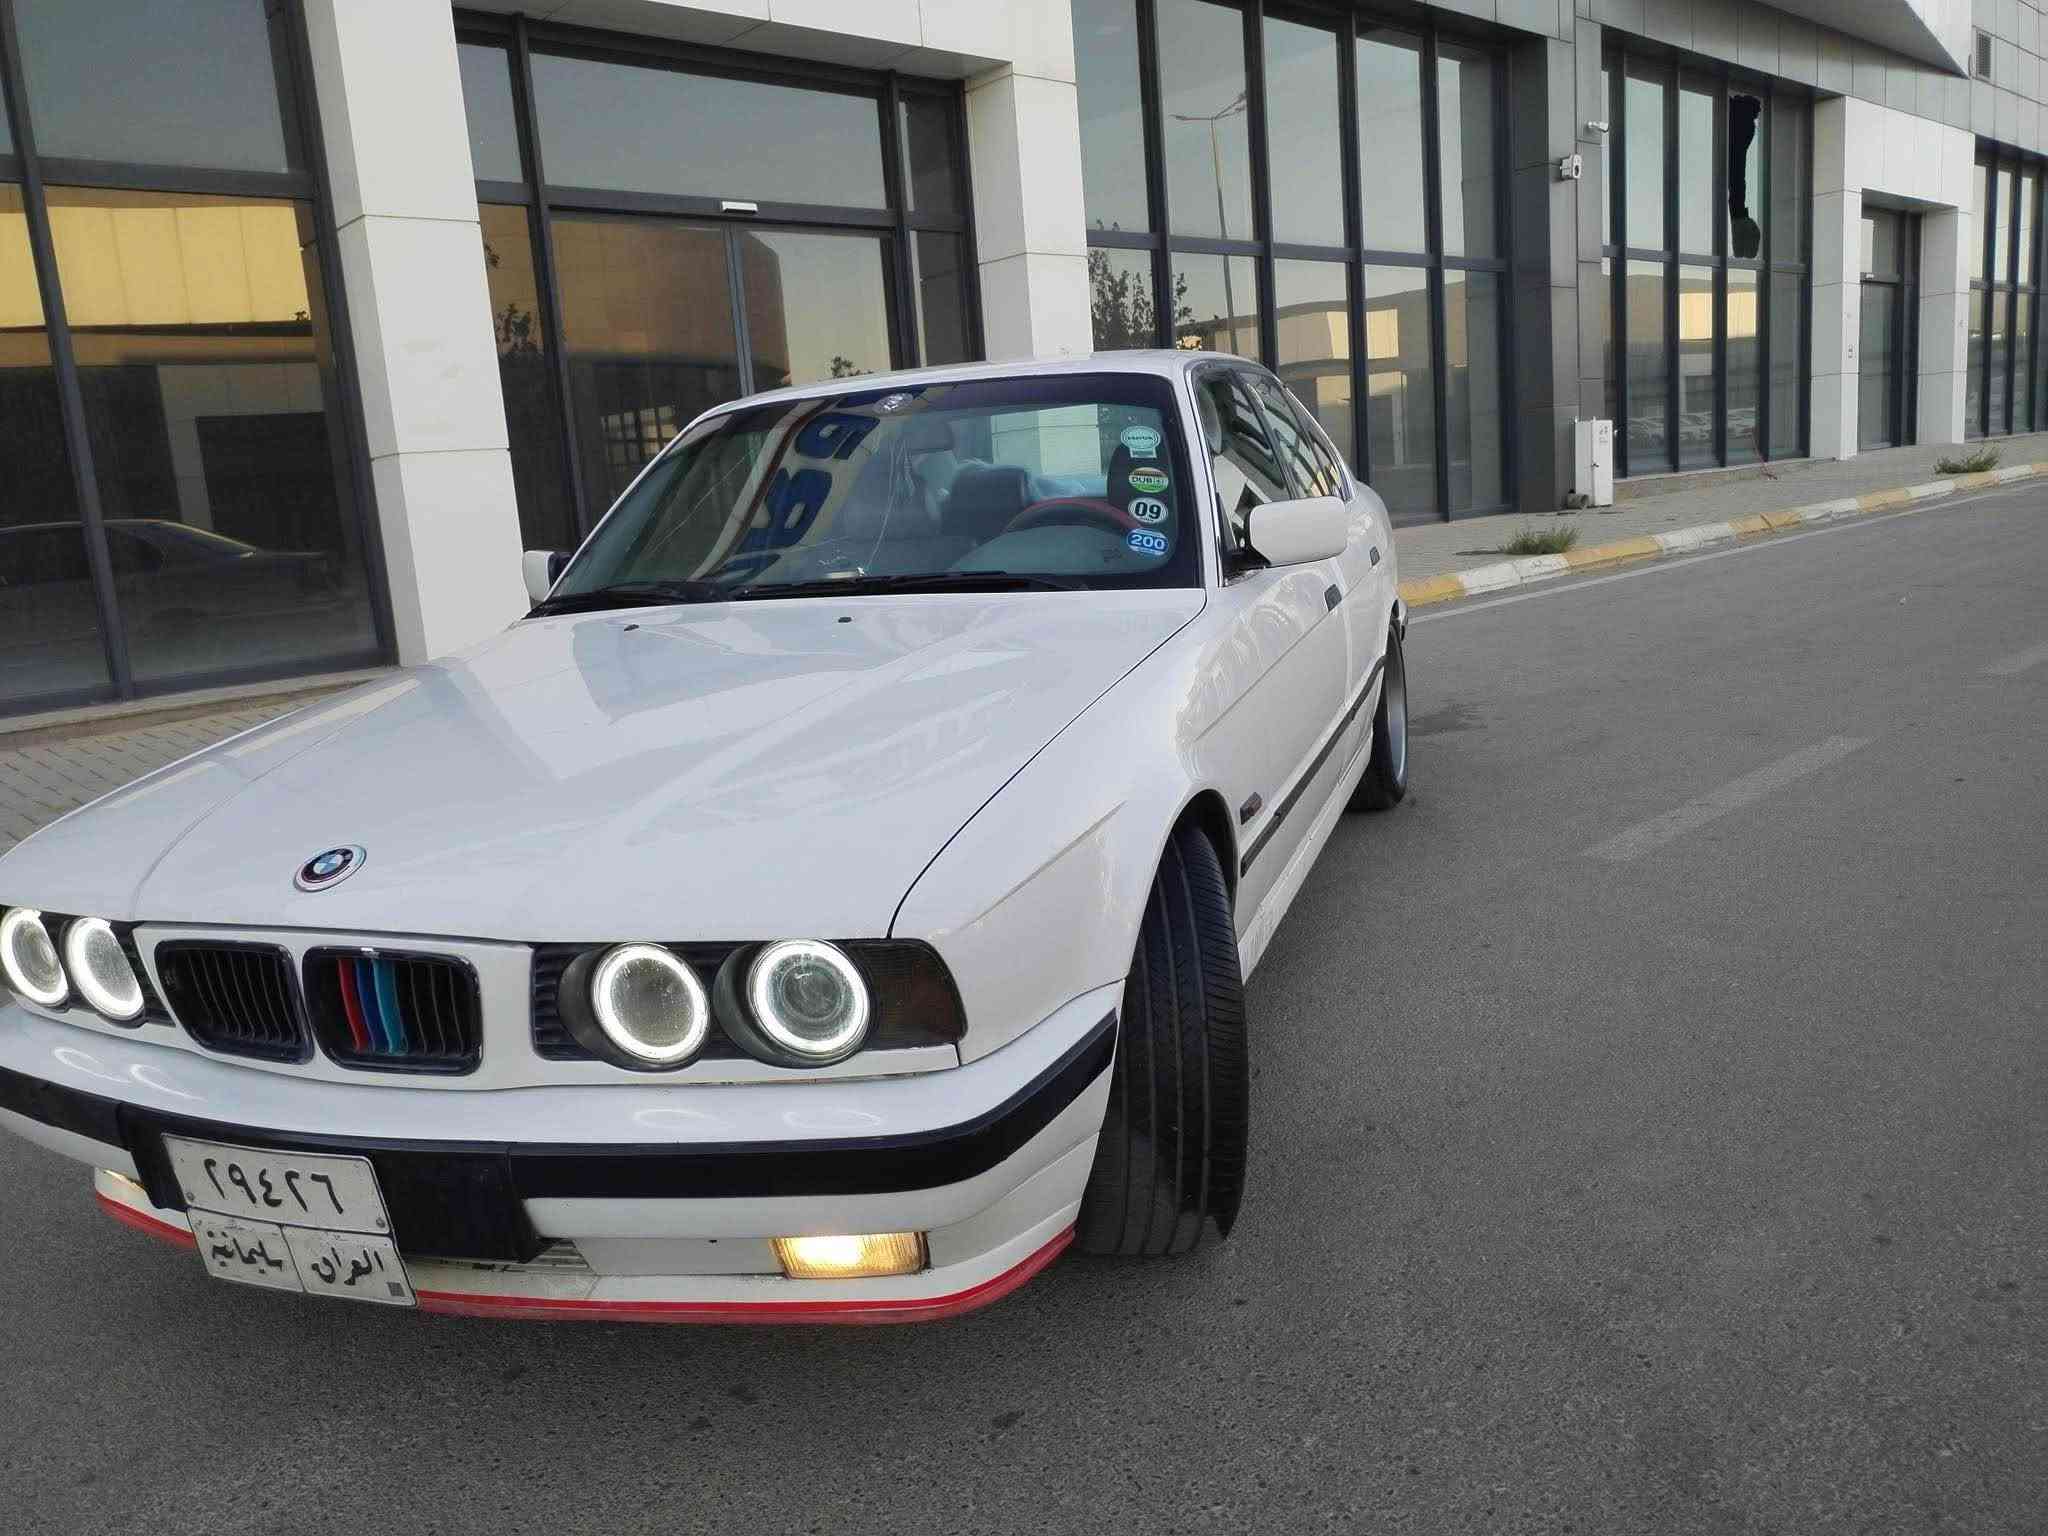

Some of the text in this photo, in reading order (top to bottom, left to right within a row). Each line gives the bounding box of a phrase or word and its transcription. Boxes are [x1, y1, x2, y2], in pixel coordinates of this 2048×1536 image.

[1135, 502, 1161, 519] 09
[1131, 534, 1165, 550] 200
[204, 1158, 344, 1214] ٢٩٤٢٦
